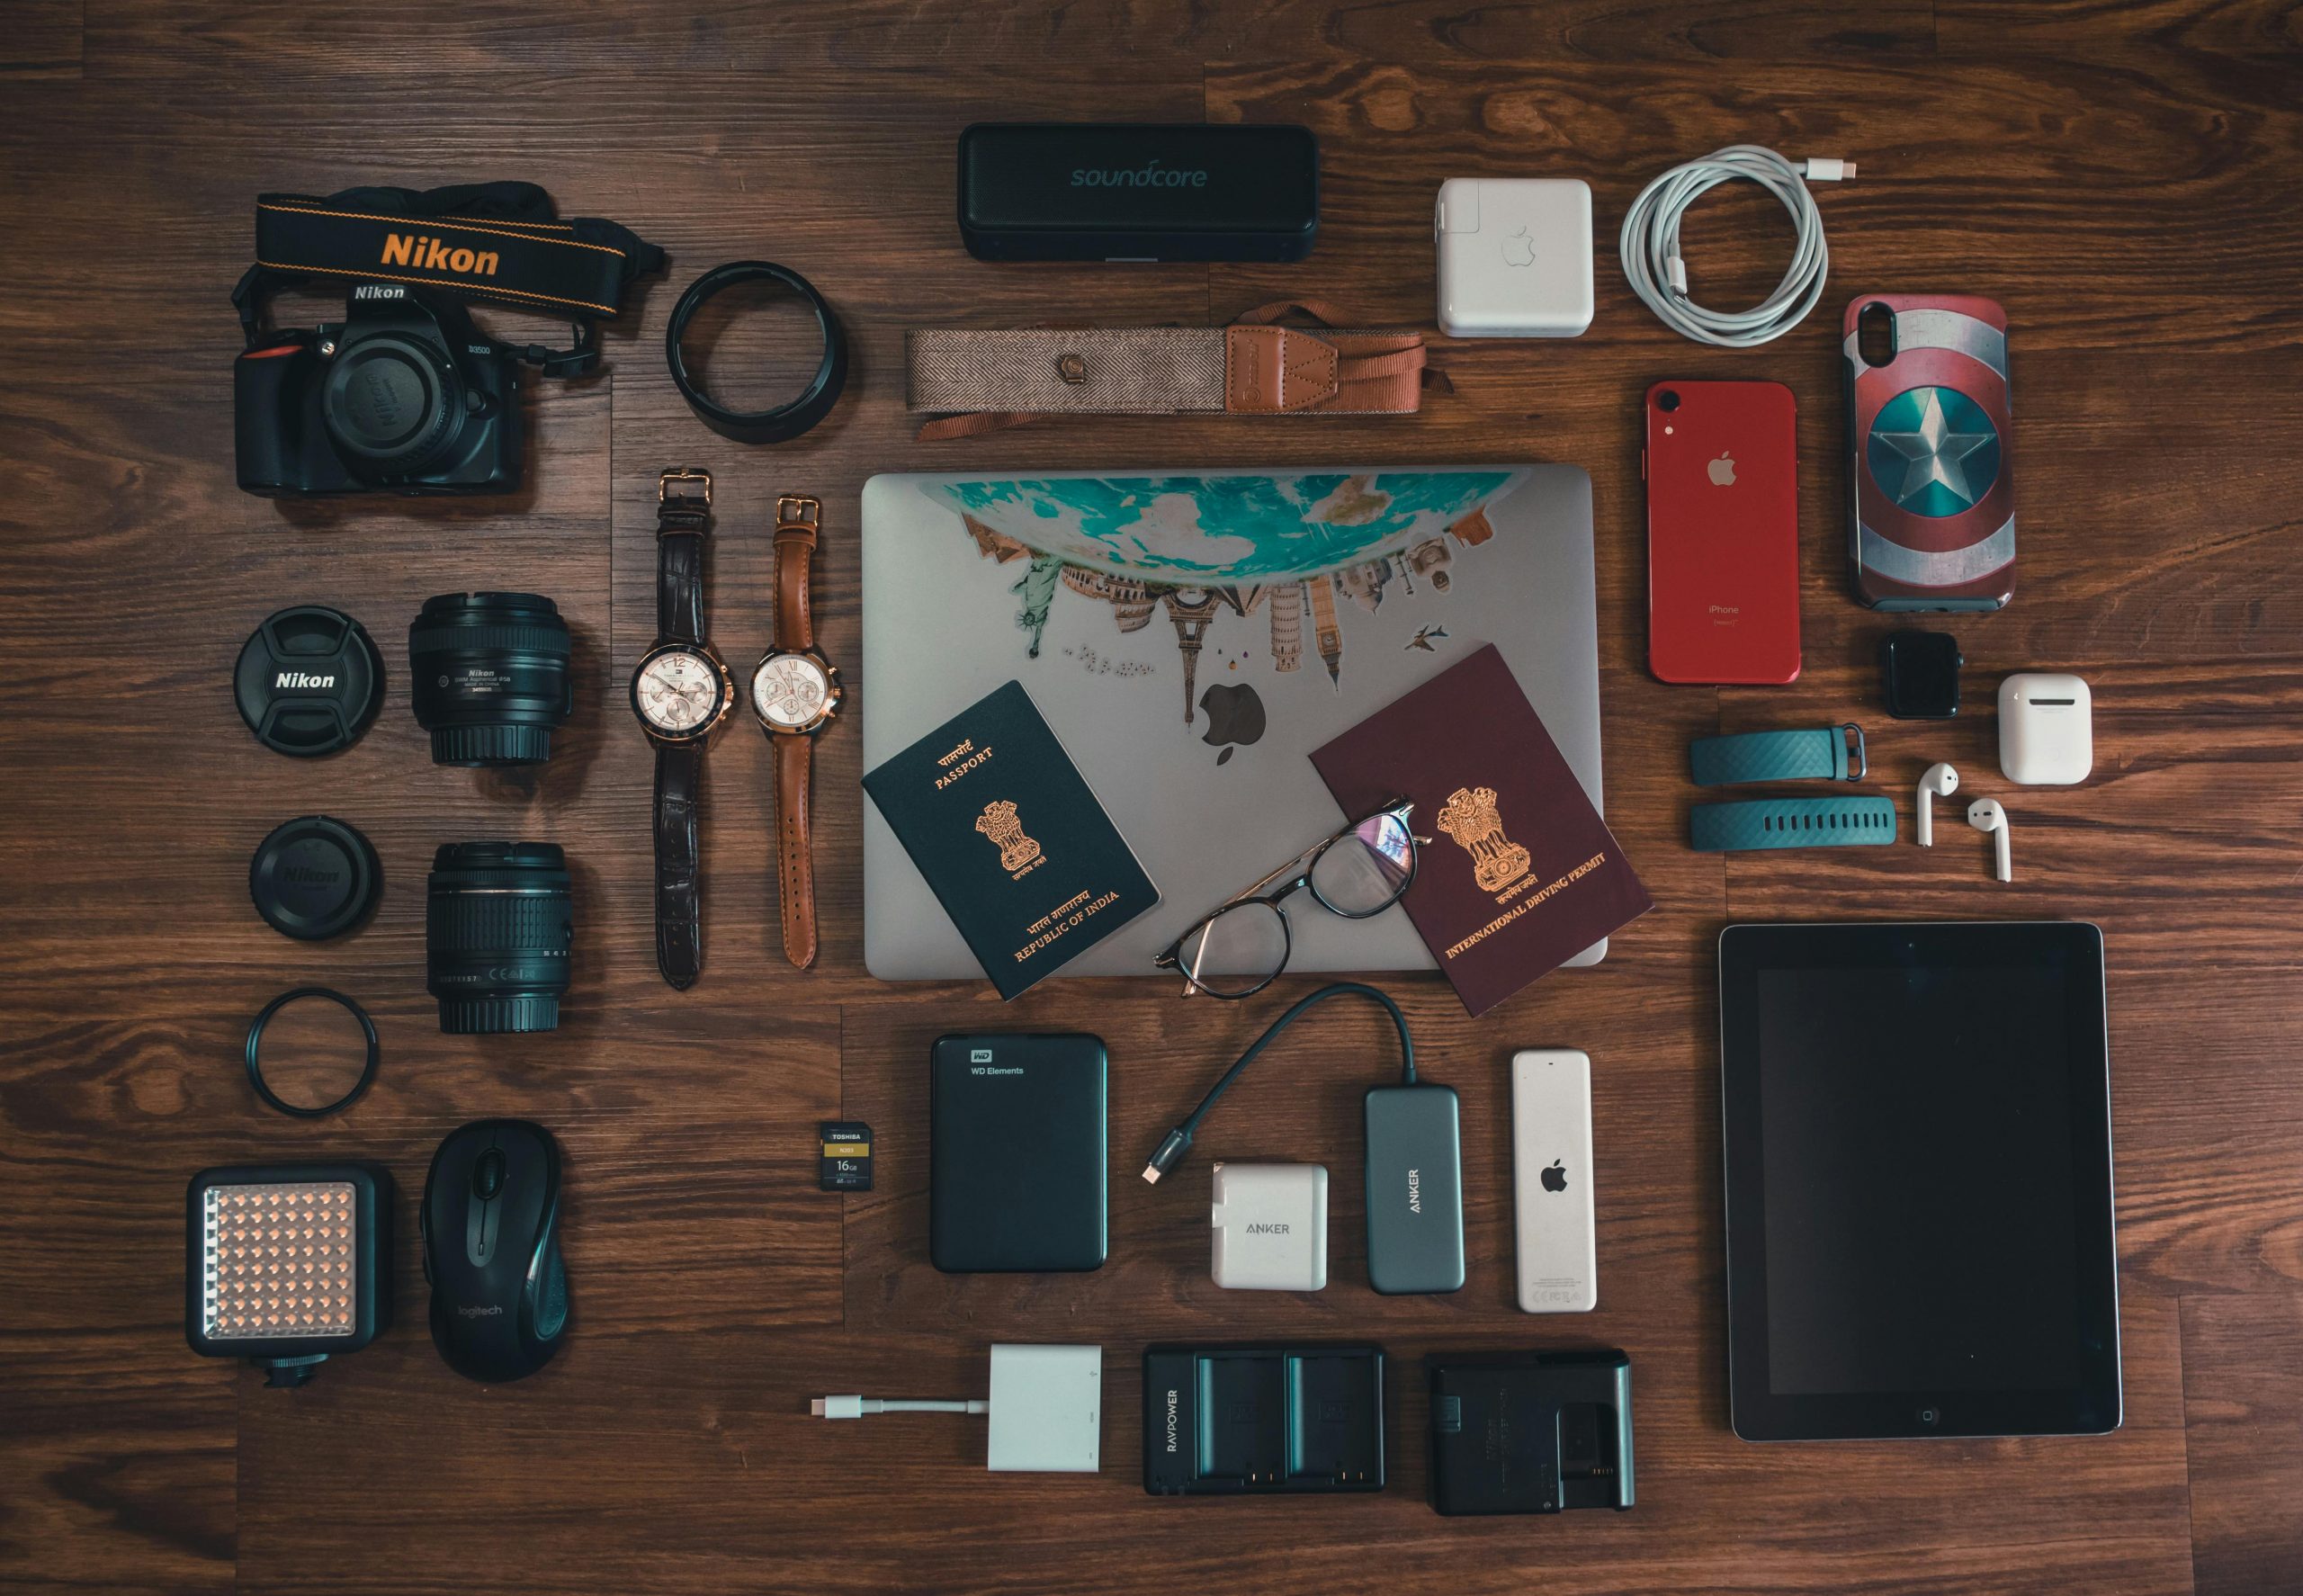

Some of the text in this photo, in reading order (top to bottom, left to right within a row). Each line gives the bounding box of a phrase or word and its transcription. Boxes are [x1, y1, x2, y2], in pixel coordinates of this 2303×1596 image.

[1071, 159, 1208, 187] soundcore
[381, 234, 499, 275] Nikon
[355, 286, 404, 300] Nikon
[469, 345, 490, 354] D3500
[1708, 605, 1740, 614] iPhone
[673, 657, 686, 668] 12
[275, 672, 335, 688] Nikon
[469, 669, 495, 677] Nikon
[937, 739, 973, 767] पासपोर्ट
[935, 747, 992, 790] PASSPORT
[283, 866, 339, 883] Nikon
[1026, 889, 1090, 935] भारत गणराज्य
[1445, 852, 1606, 959] INTERNATIONAL DRIVING PERMIT
[1015, 891, 1120, 963] REPUBLIC OF INDIA
[974, 1052, 990, 1060] WD
[971, 1067, 1024, 1075] WD Elements
[1408, 1169, 1420, 1214] ANKER
[1246, 1223, 1289, 1234] ANKER
[458, 1305, 503, 1319] logitech
[1167, 1390, 1178, 1452] RAVPOWER
